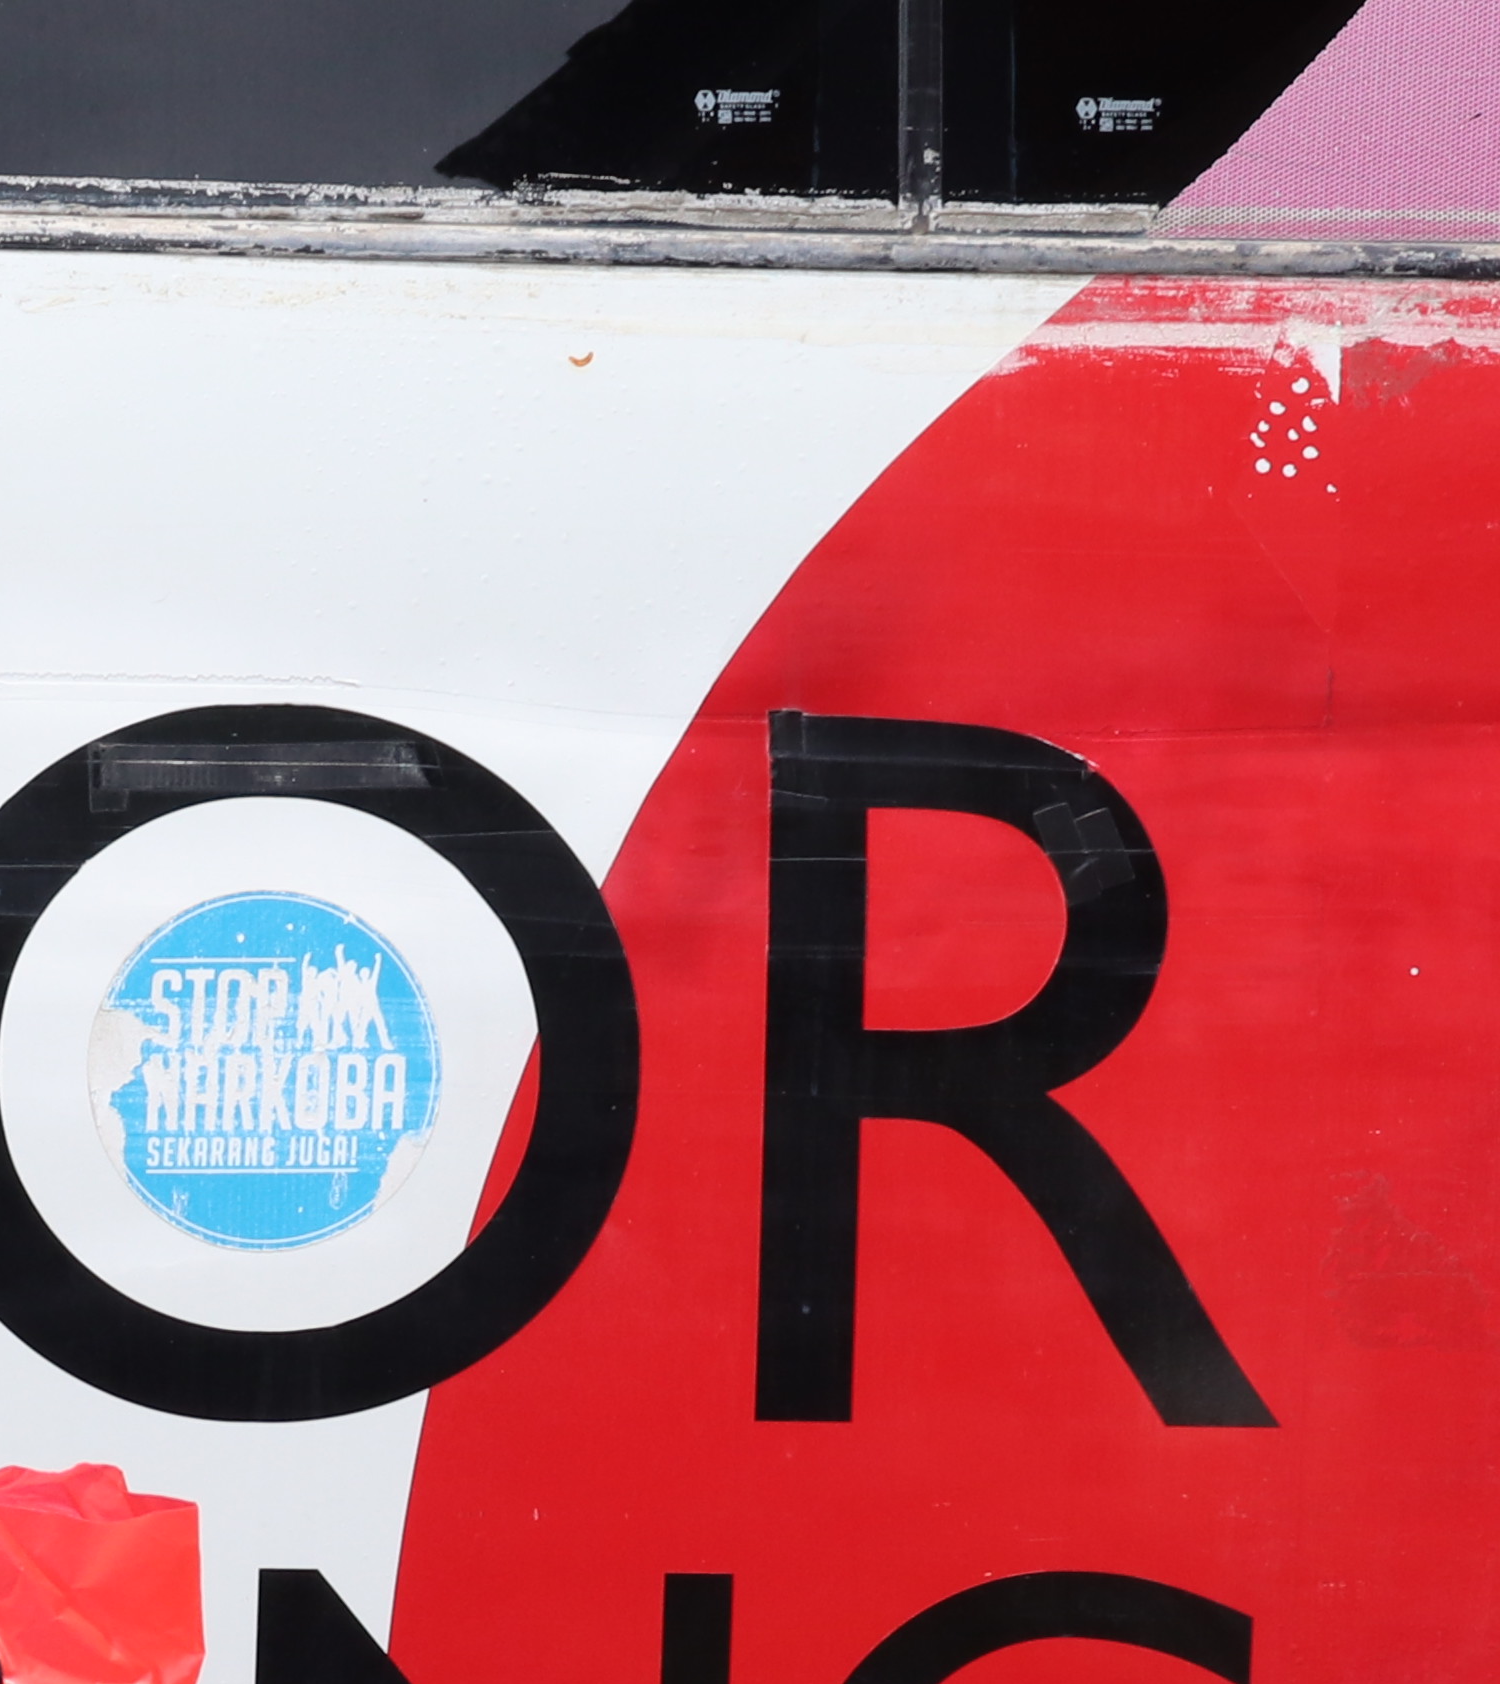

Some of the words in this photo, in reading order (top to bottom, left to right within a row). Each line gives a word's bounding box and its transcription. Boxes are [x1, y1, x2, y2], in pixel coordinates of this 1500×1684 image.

[150, 966, 289, 1051] STOP
[142, 1053, 407, 1134] NARKOBA
[146, 1136, 275, 1168] SEKARANG
[285, 1135, 358, 1166] JUGA!
